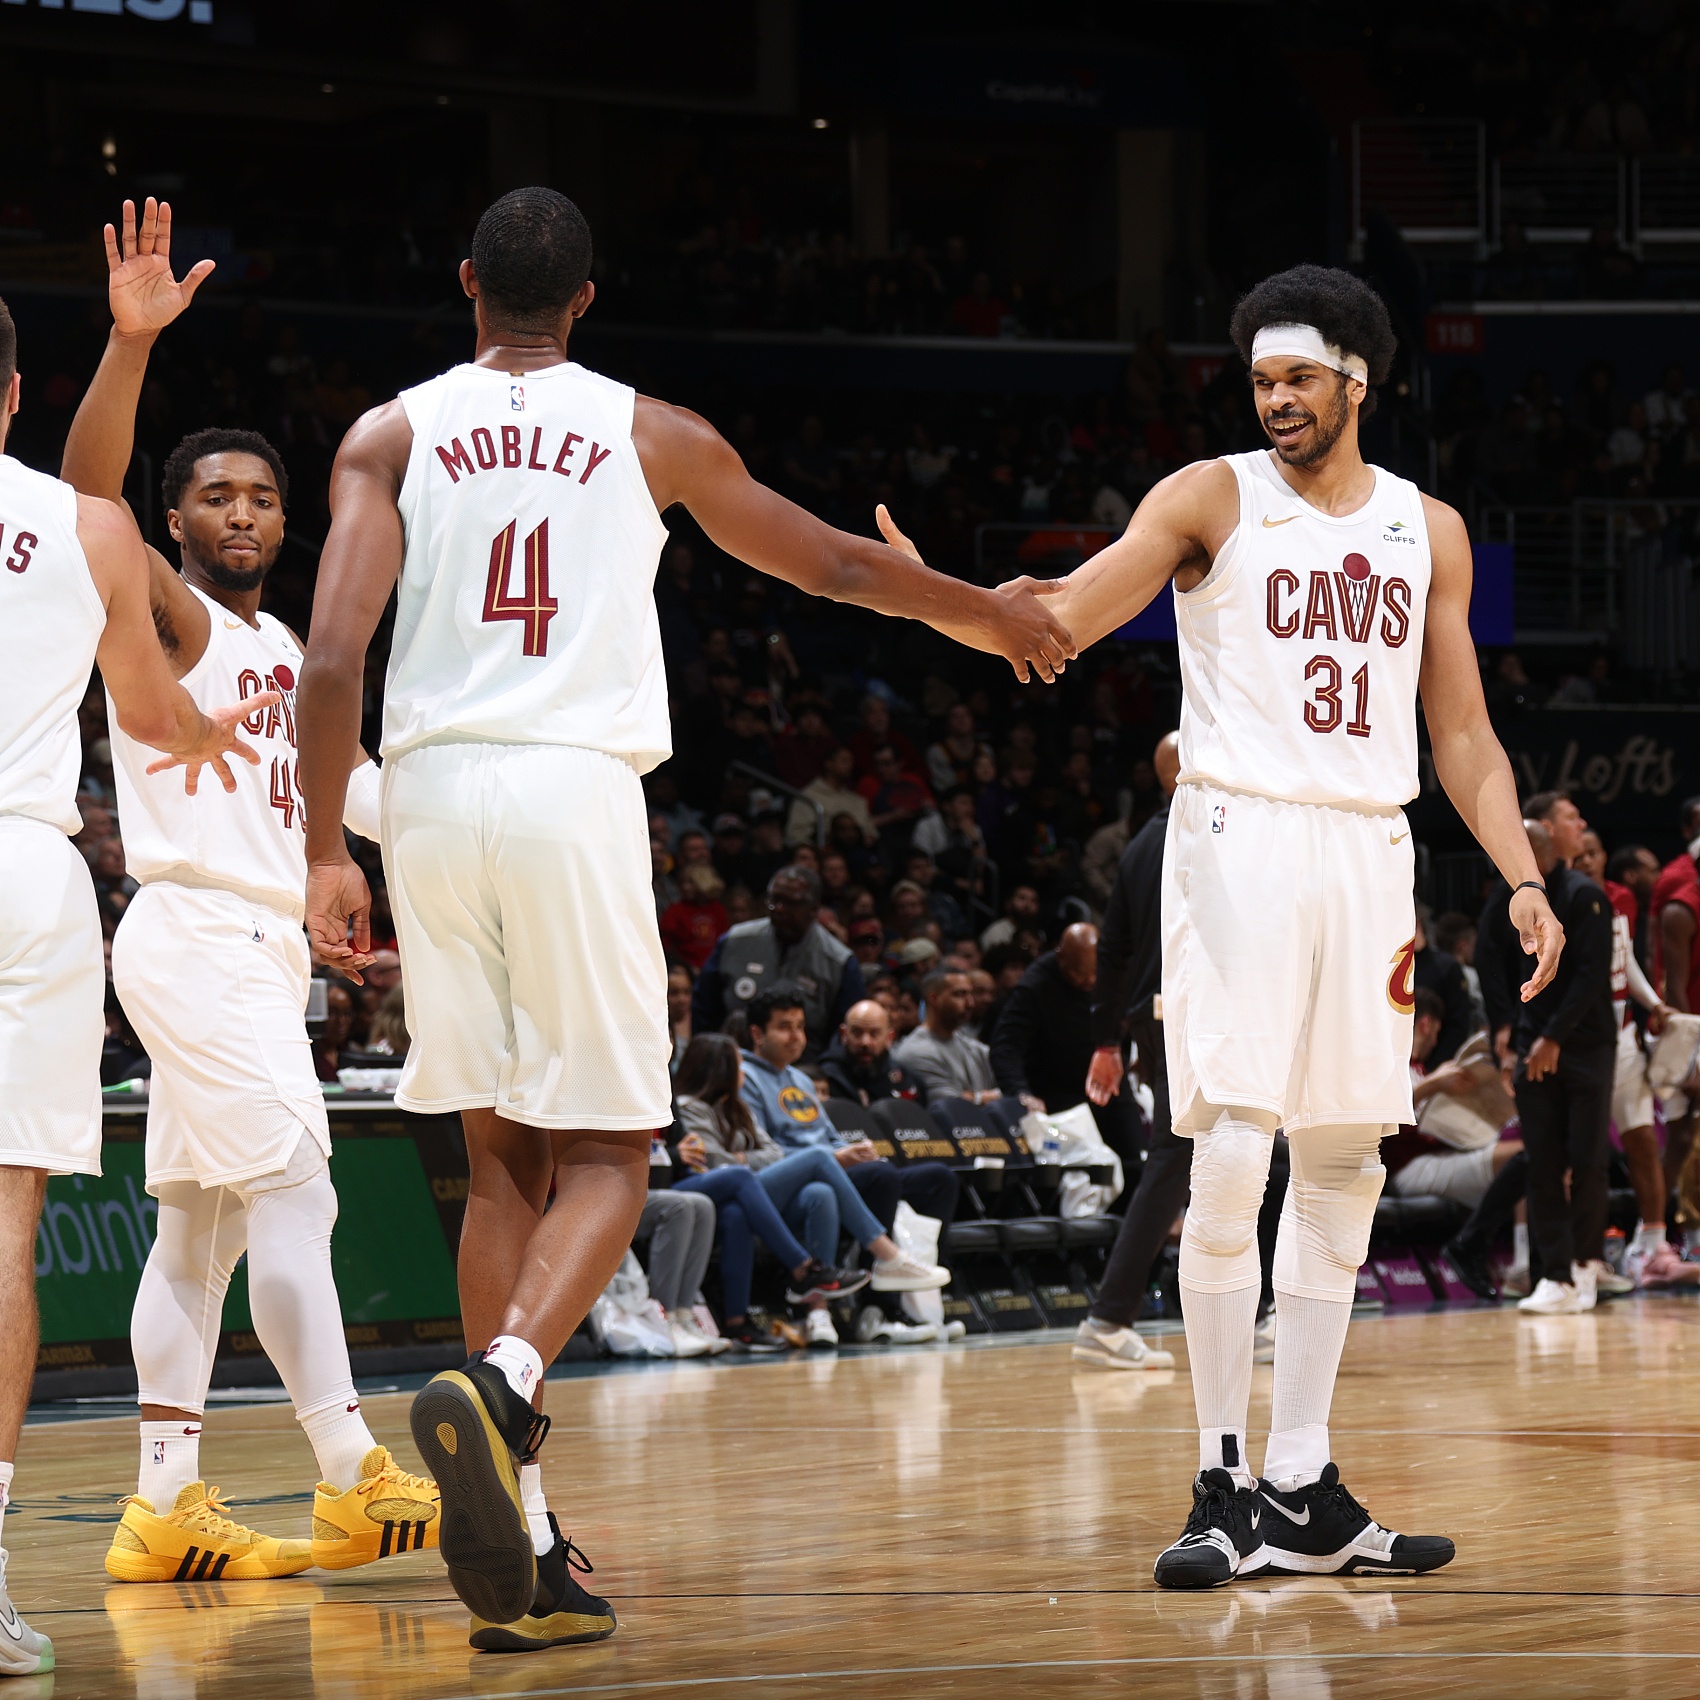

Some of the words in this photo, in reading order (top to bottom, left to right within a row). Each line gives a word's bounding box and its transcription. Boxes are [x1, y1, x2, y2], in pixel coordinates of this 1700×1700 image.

[435, 425, 611, 485] MOBLEY
[0, 523, 38, 574] S
[1383, 534, 1415, 545] CLIFFS
[482, 516, 558, 657] 4
[1267, 568, 1411, 648] CAVS
[1304, 655, 1371, 738] 31
[1555, 733, 1684, 804] Lofts
